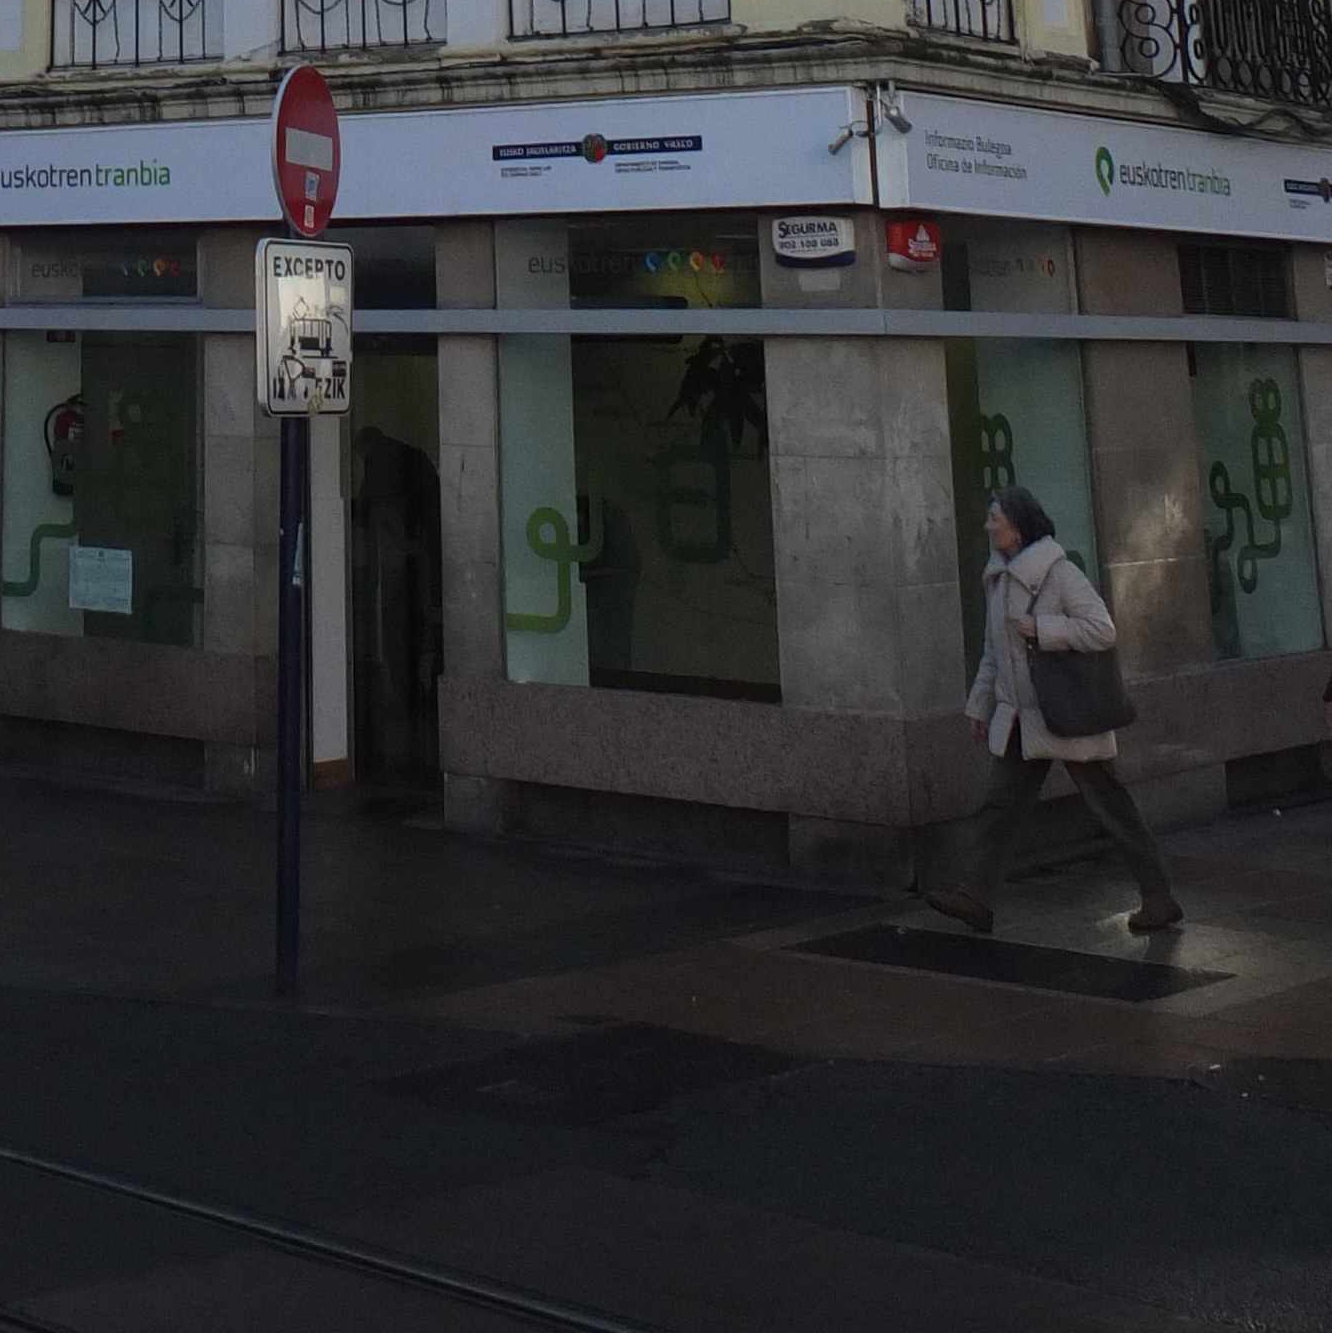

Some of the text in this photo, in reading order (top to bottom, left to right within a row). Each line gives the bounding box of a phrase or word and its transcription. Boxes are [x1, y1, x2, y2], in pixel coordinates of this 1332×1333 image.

[613, 141, 660, 151] GOBIERNO
[664, 139, 694, 148] VASCO
[925, 130, 1012, 159] Informazio Bulegoa
[95, 159, 171, 187] tranbia
[927, 153, 959, 173] Oficina
[961, 159, 972, 174] de
[1119, 162, 1231, 196] euskotren tranbia
[778, 221, 838, 239] SEGURMA
[273, 256, 346, 281] EXCEPTO
